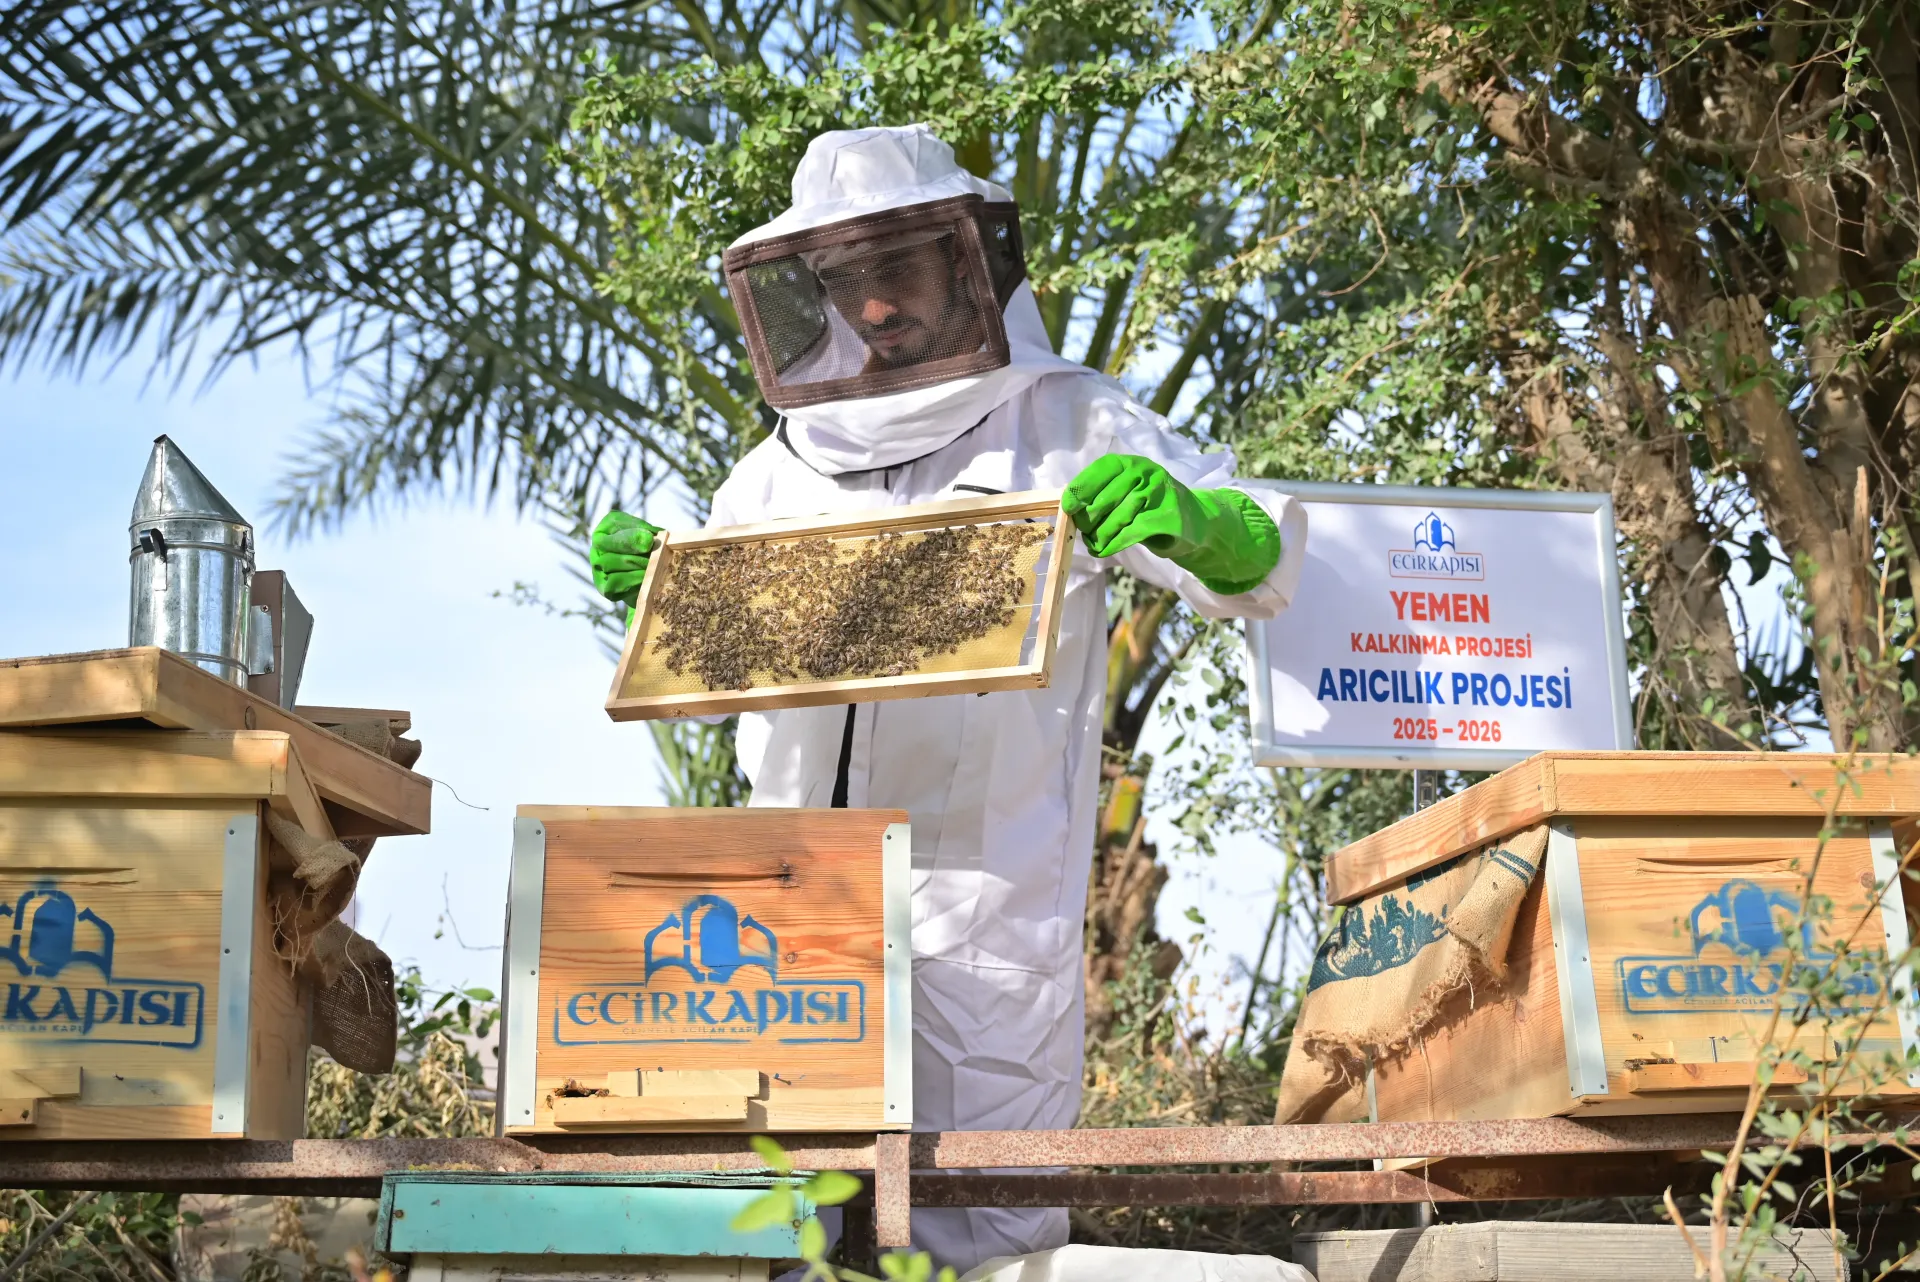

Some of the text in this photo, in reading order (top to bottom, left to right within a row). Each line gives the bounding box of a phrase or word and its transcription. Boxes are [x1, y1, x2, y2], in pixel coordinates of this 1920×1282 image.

[1389, 590, 1491, 623] YEMEN
[1351, 632, 1533, 658] KALKINMA PROJESİ
[1317, 666, 1573, 709] ARICILIK PROJESİ
[1393, 718, 1438, 740] 2025
[1458, 720, 1501, 742] 2026
